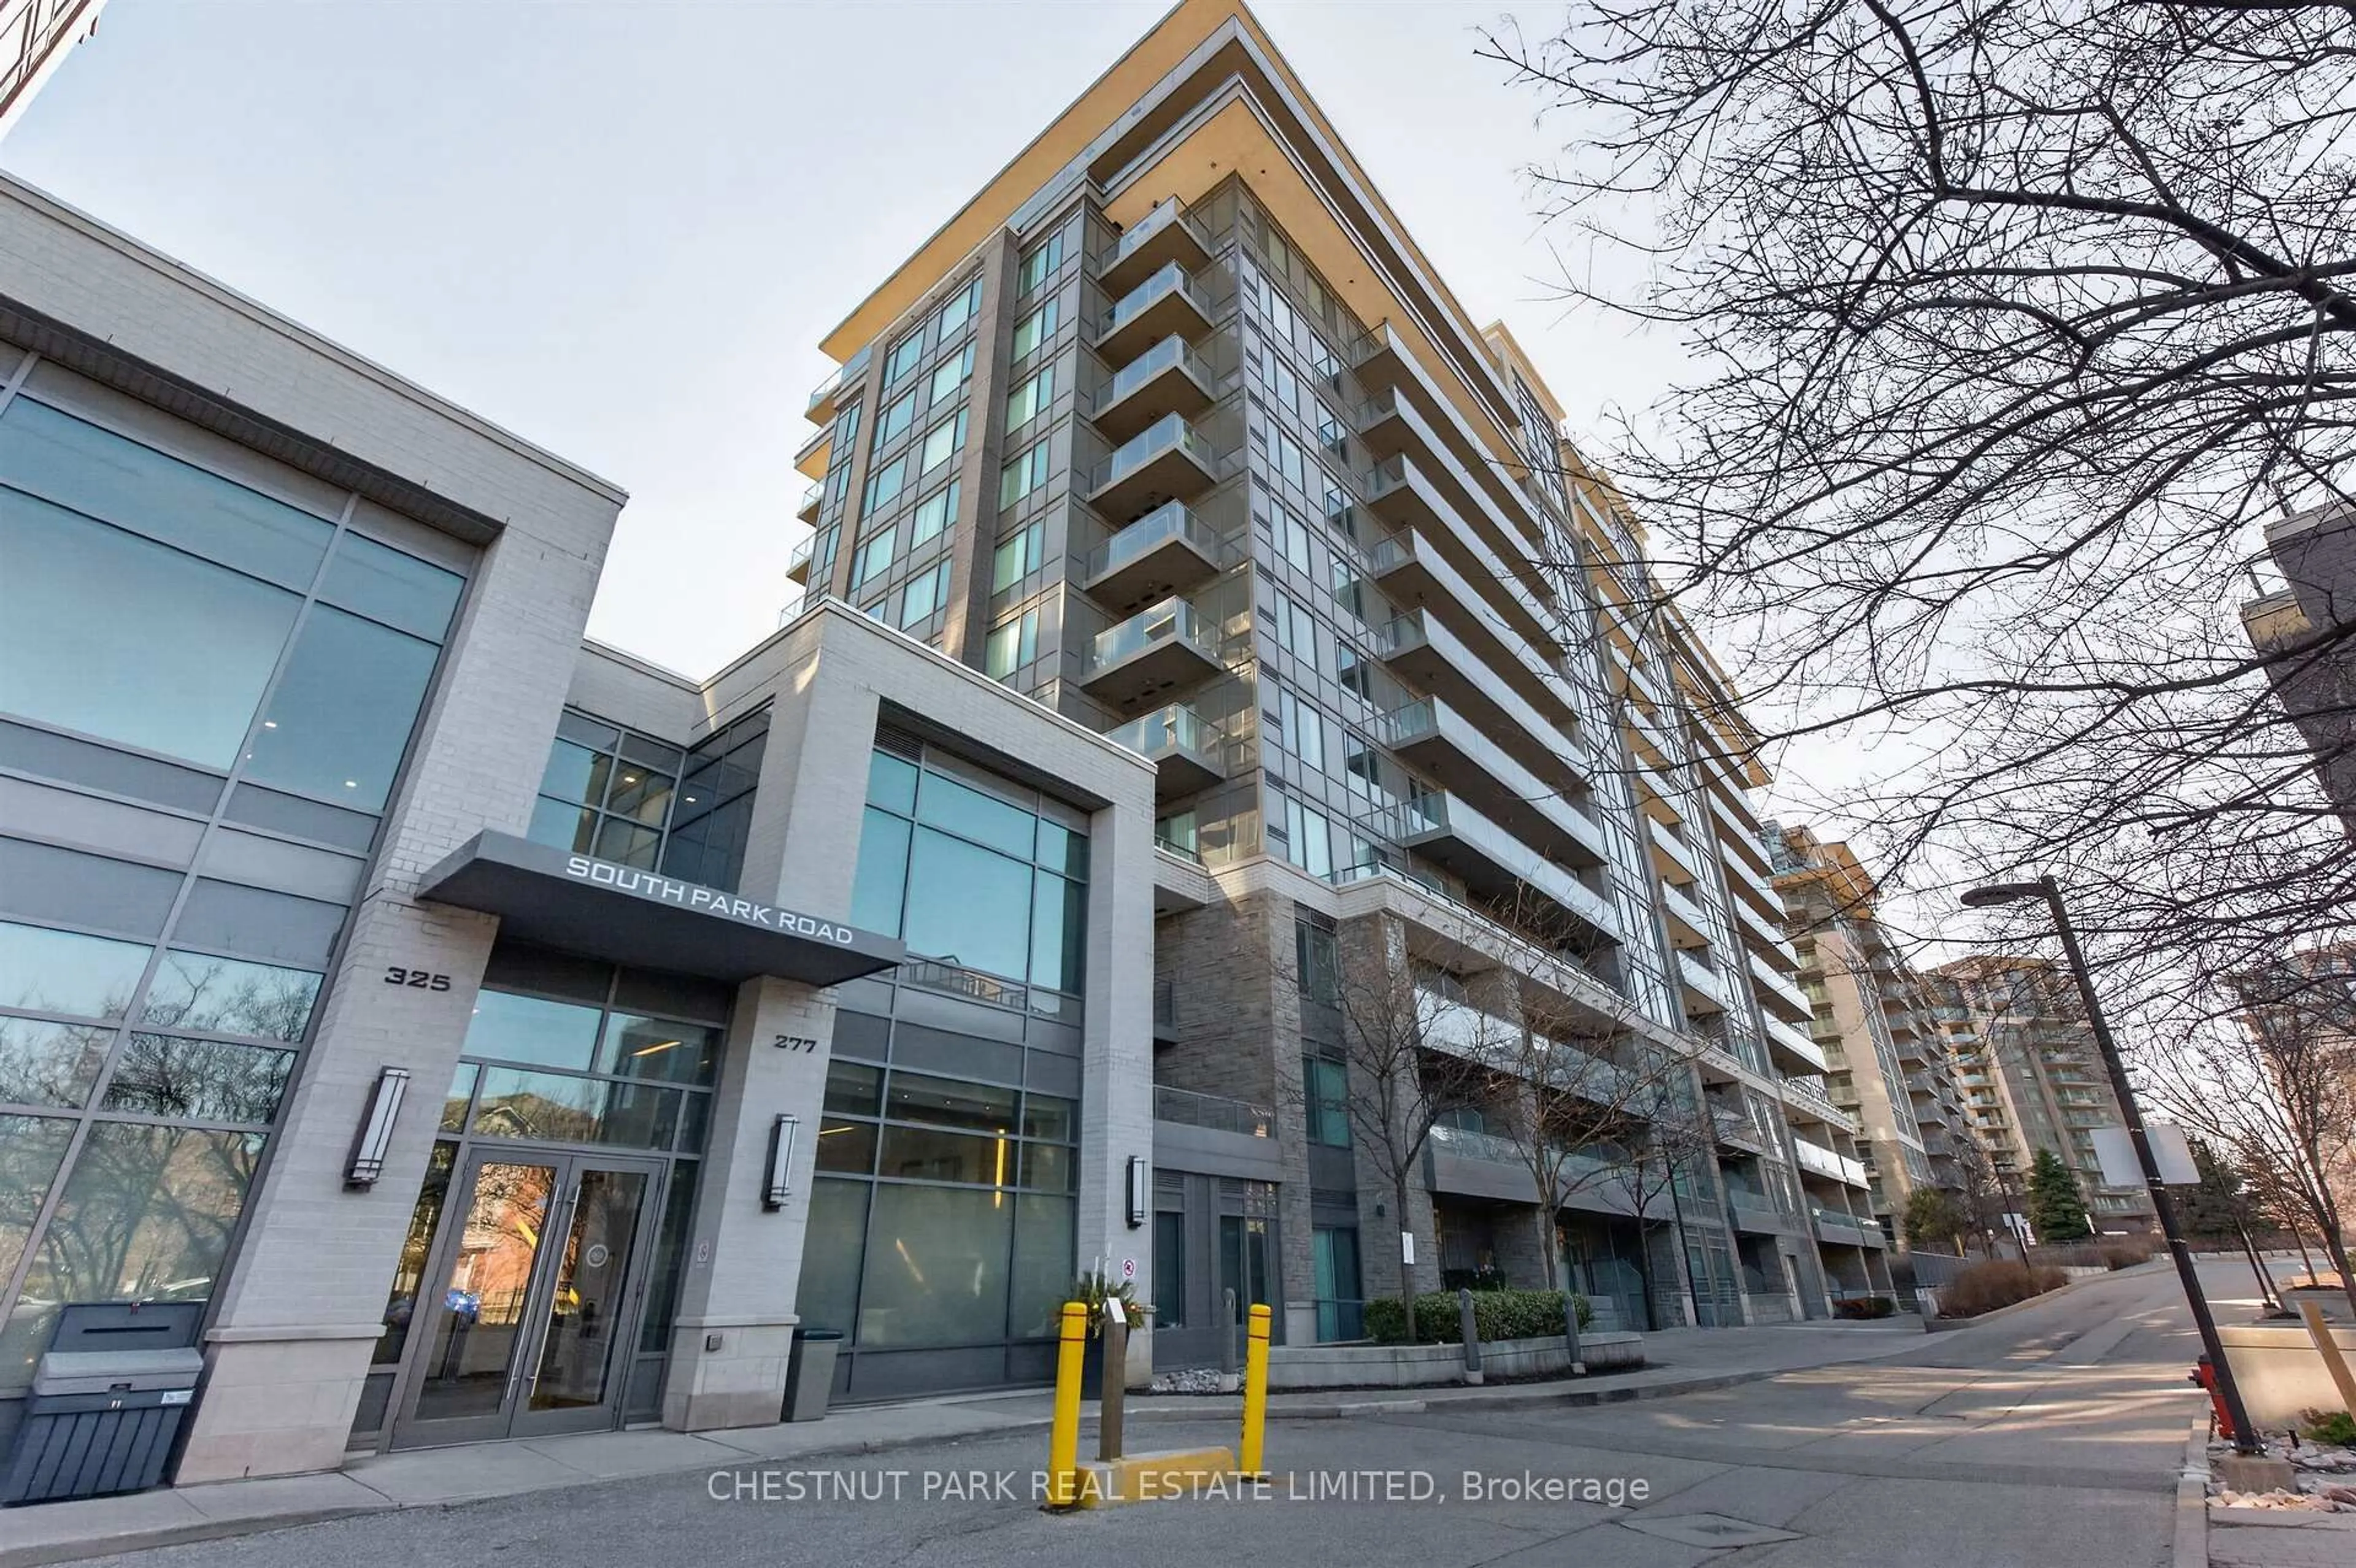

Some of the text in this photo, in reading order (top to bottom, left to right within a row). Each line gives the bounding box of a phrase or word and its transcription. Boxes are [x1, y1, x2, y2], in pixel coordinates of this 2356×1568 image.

[566, 857, 853, 944] SOUTH PARK ROAD
[384, 967, 451, 991] 325
[774, 1035, 817, 1053] 277
